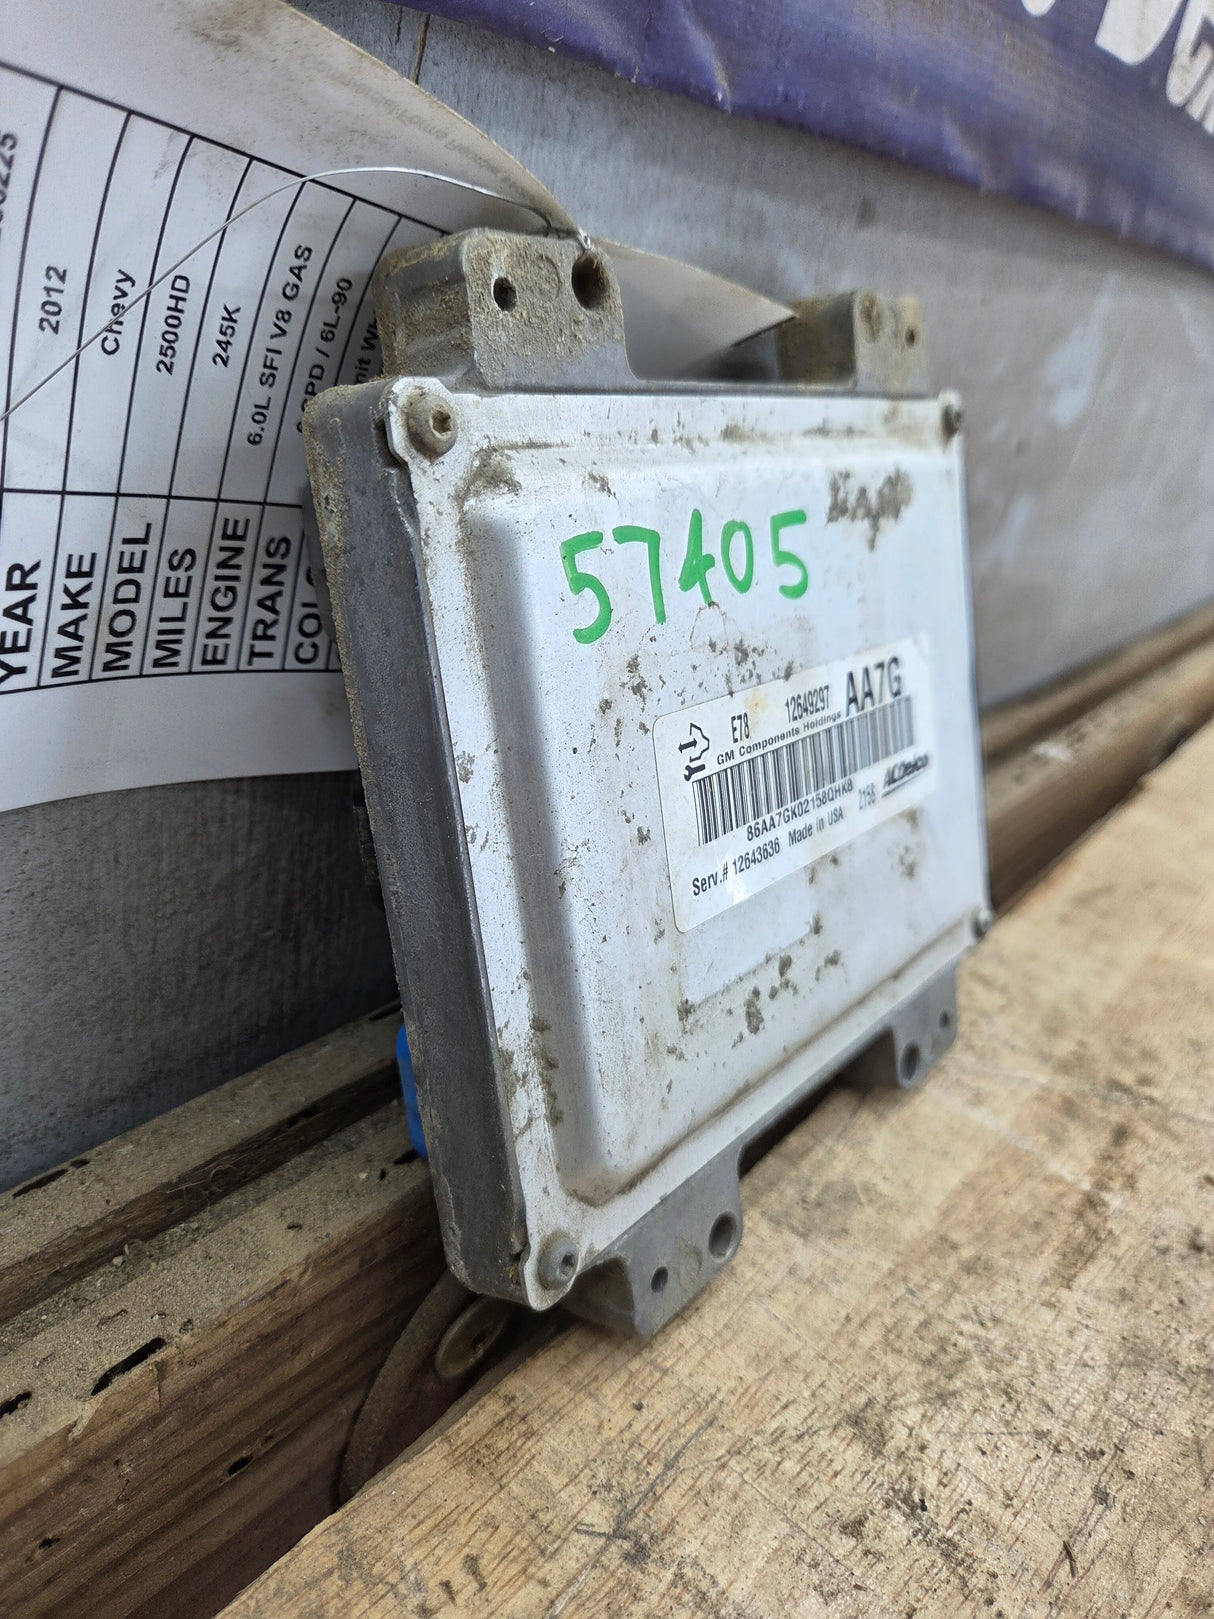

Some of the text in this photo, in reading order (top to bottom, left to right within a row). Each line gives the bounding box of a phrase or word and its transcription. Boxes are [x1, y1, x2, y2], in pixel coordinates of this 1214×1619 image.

[39, 265, 67, 335] 2012
[101, 269, 136, 356] Chevy
[157, 274, 191, 376] 2500HD
[212, 304, 242, 368] 245K
[247, 245, 313, 446] 6.0L SFI V8 GAS
[320, 277, 353, 343] 6L-90
[0, 559, 41, 683] YEAR
[51, 551, 97, 679] MAKE
[102, 522, 153, 672] MODEL
[152, 547, 197, 669] MILES
[202, 516, 251, 666] ENGINE
[247, 536, 292, 667] TRANS
[559, 508, 809, 645] 57405
[716, 710, 842, 766] GM Components Holdings
[731, 684, 830, 744] E78 12649297
[845, 656, 902, 718] AA7G
[732, 836, 781, 875] 12643636
[788, 823, 813, 848] Made
[816, 816, 825, 833] in
[827, 805, 845, 827] USA
